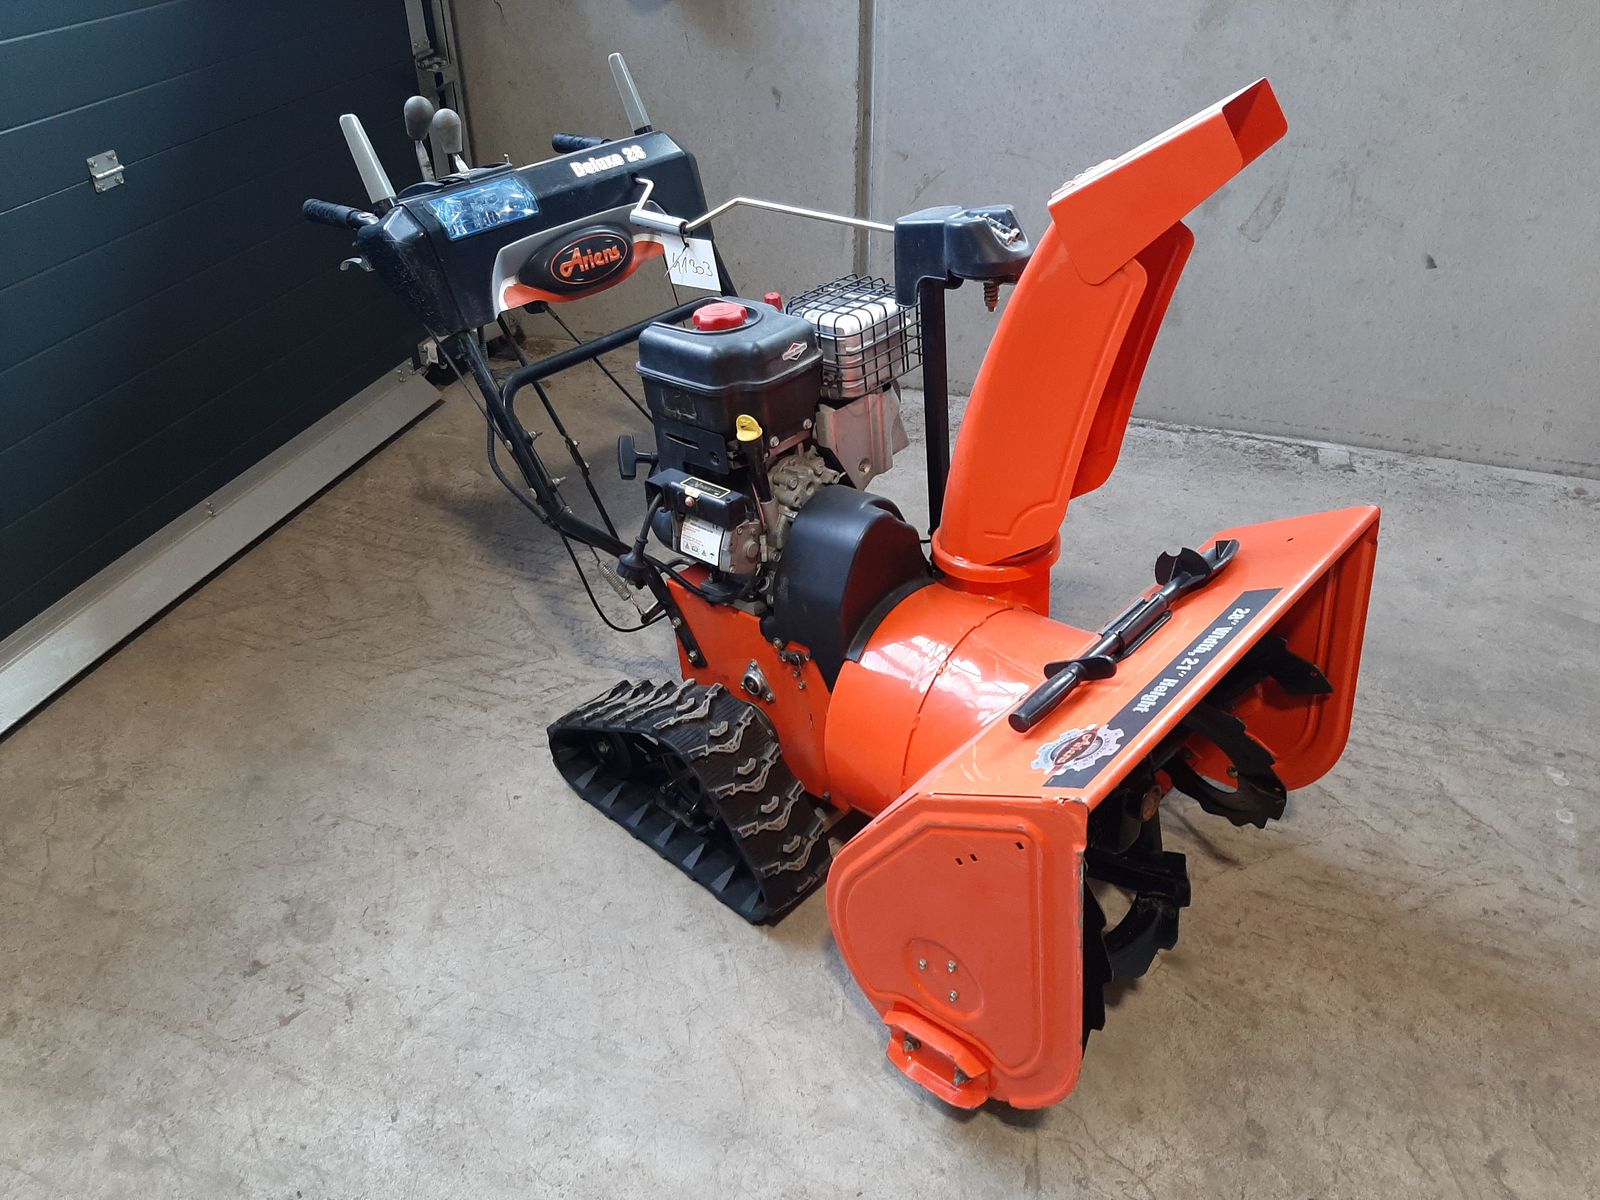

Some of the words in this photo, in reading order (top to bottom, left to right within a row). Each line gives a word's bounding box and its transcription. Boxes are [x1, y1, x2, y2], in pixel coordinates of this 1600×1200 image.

[570, 154, 625, 178] Deluxe
[621, 144, 647, 163] 28
[559, 246, 622, 278] Ariens
[1132, 678, 1179, 713] Height
